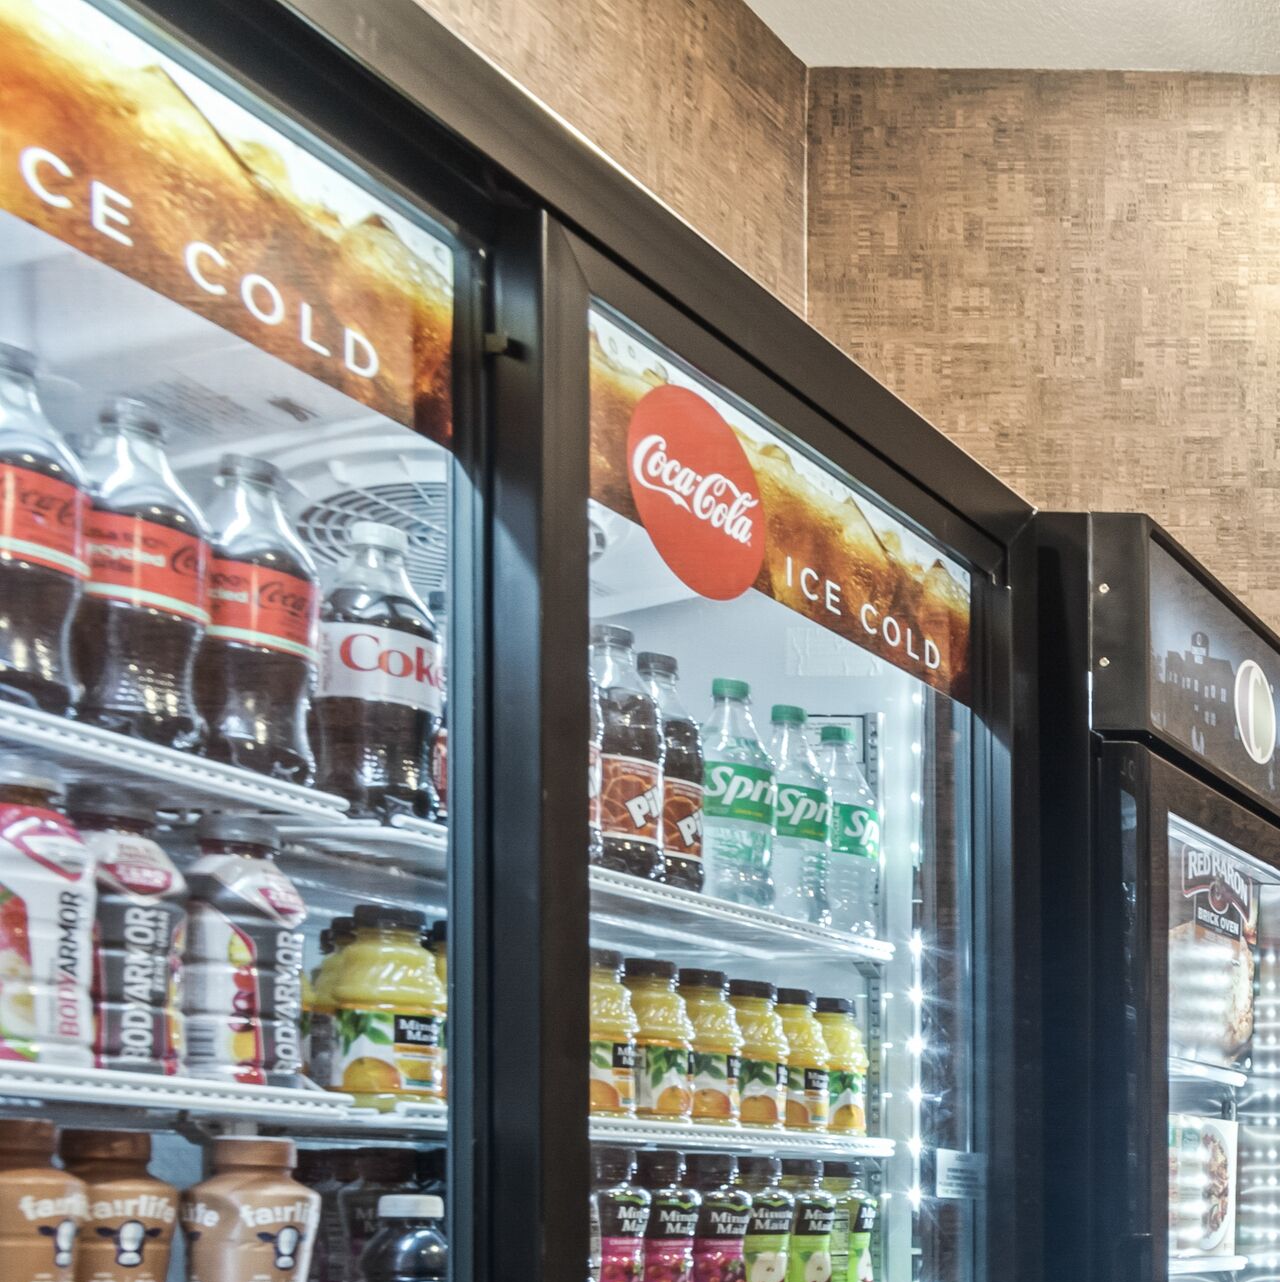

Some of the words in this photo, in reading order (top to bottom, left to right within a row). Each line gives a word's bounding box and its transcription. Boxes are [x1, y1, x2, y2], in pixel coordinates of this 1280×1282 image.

[20, 146, 134, 248] CE
[184, 241, 380, 379] COLD
[632, 434, 759, 547] Coca-Cola
[785, 555, 841, 616] ICE
[860, 603, 941, 671] COLD
[1188, 850, 1211, 879] RED
[1197, 906, 1219, 927] BRICK
[1220, 916, 1240, 935] OVEN
[56, 890, 80, 1037] BODYARMOR
[754, 1219, 789, 1230] Maid
